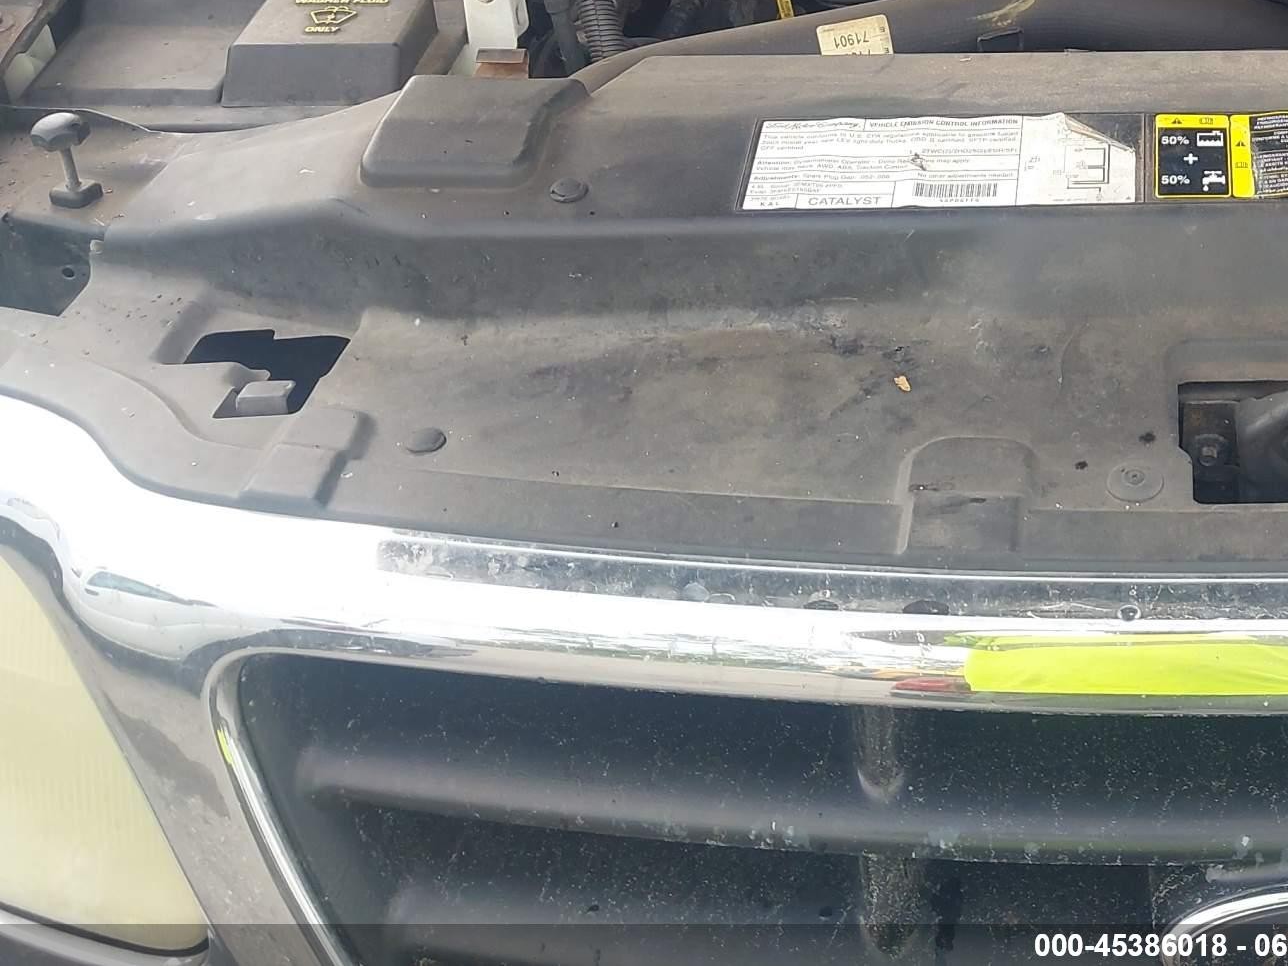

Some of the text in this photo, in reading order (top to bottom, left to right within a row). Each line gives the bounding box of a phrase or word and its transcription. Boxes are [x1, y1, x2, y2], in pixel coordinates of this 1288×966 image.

[832, 30, 870, 49] 71901
[1161, 136, 1190, 145] 50%
[1161, 175, 1191, 185] 50%
[808, 197, 882, 206] CATALYST
